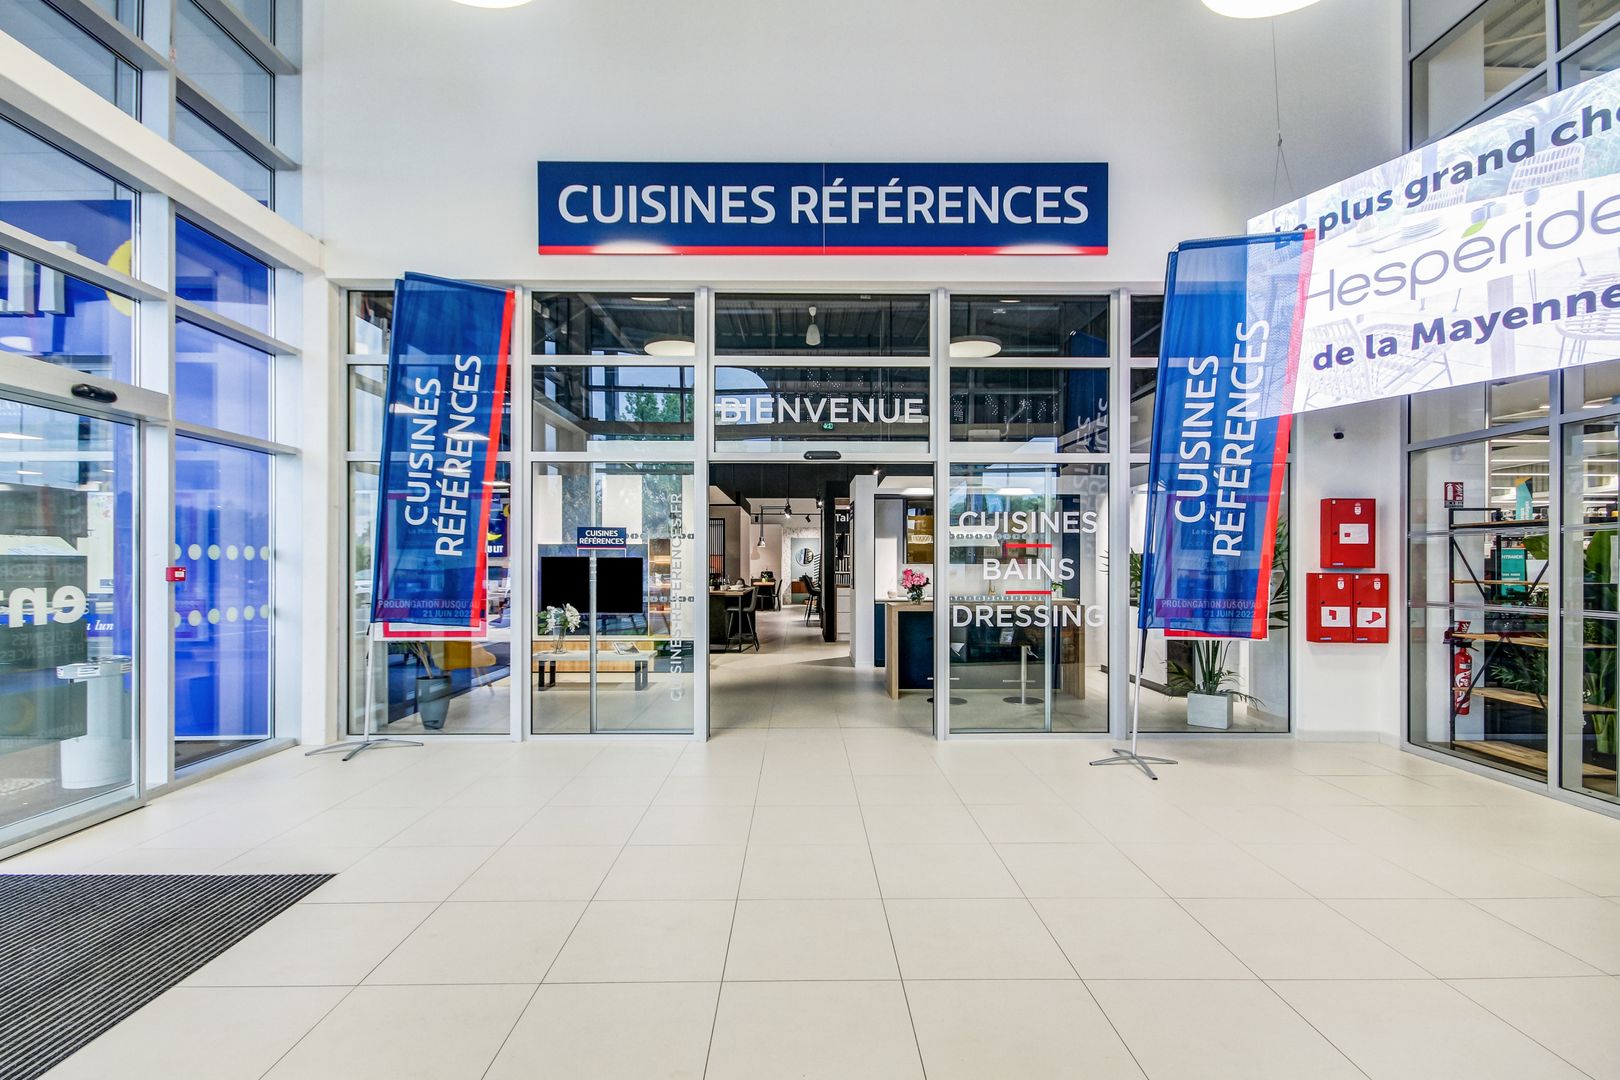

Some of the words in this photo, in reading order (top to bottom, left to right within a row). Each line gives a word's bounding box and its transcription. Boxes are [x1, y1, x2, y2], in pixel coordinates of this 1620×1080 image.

[1318, 188, 1393, 240] plus
[1404, 127, 1535, 208] grand
[1551, 105, 1620, 146] ch
[558, 184, 776, 225] CUISINES
[791, 178, 1089, 225] RÉFÉRENCES
[1312, 344, 1354, 371] de
[1366, 333, 1397, 359] la
[1412, 283, 1620, 350] Mayenne
[720, 397, 924, 424] BIENVENUE
[1174, 355, 1219, 523] CUISINES
[1210, 320, 1270, 557] RÉFÉRENCES
[404, 377, 441, 526] CUISINES
[432, 354, 482, 557] RÉFÉRENCES
[585, 529, 618, 537] CUISINES
[959, 511, 1097, 534] CUISINES
[579, 536, 625, 545] RÉFÉRENCES
[983, 558, 1075, 581] BAINS
[378, 600, 440, 609] PROLONGATION
[423, 610, 433, 618] 21
[434, 610, 452, 618] JUIN
[1161, 600, 1221, 609] PROLONGATION
[1216, 610, 1234, 618] JUIN
[952, 605, 1104, 628] DRESSING
